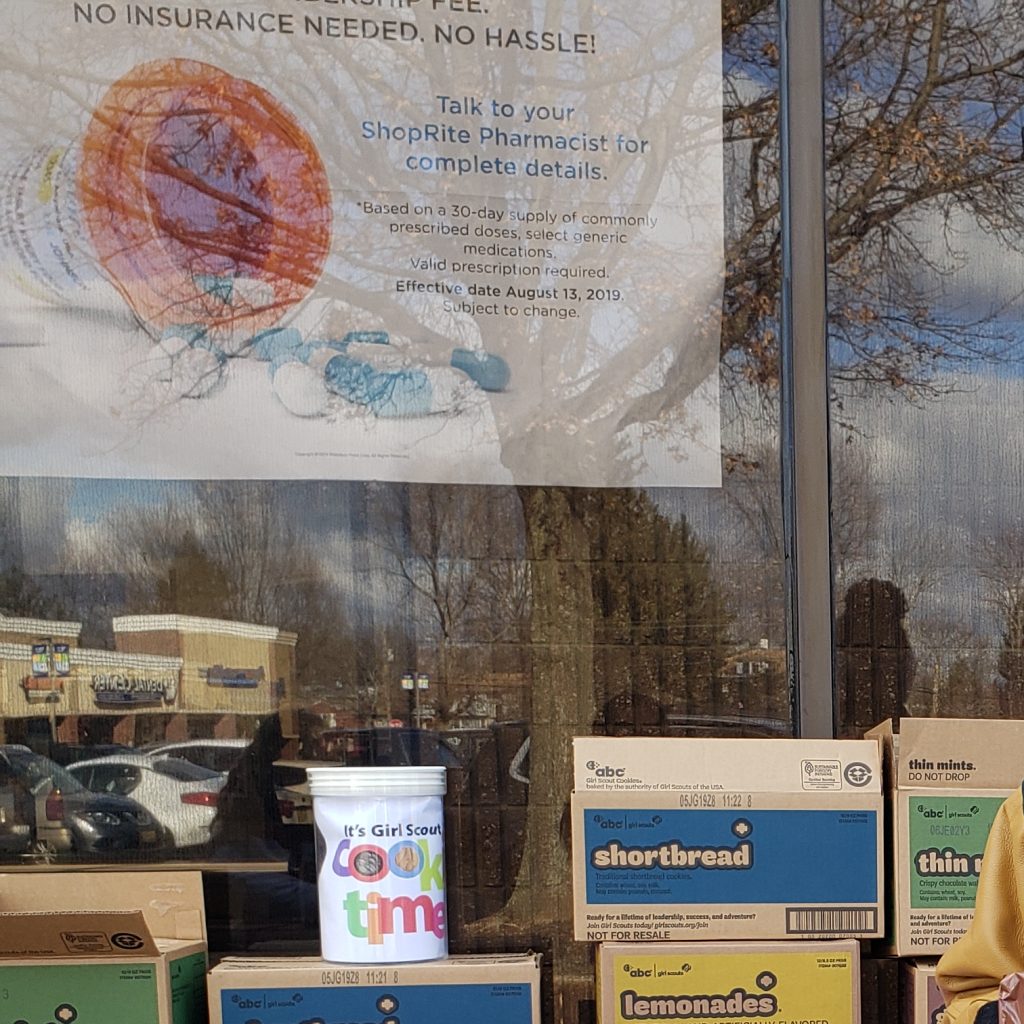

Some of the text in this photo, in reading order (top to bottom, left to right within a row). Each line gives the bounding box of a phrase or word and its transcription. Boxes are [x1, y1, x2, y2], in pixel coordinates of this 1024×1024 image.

[74, 3, 596, 54] NO INSURANCE NEEDED. NO HASSLE!
[436, 95, 575, 124] Talk to your
[361, 121, 649, 154] ShopRite Pharmacist for
[405, 154, 608, 181] complete details.
[414, 205, 433, 216] on
[437, 206, 447, 217] a
[450, 205, 504, 222] 30-day
[509, 210, 558, 225] supply
[561, 211, 578, 224] of
[581, 213, 658, 229] commonly
[389, 221, 628, 245] prescribed doses, select generic
[463, 244, 557, 260] medications.
[410, 258, 610, 280] Valid prescription required.
[396, 280, 625, 302] Effective date August 13, 2019.
[443, 300, 580, 320] Subject to change.
[908, 759, 934, 770] thin
[908, 772, 971, 781] DO NOT DROP
[344, 824, 367, 837] It's
[371, 824, 403, 837] Girl
[594, 843, 750, 867] shortbread
[918, 851, 969, 873] thin
[587, 931, 671, 940] NOT FOR RESALE
[910, 937, 951, 946] NOT FOR
